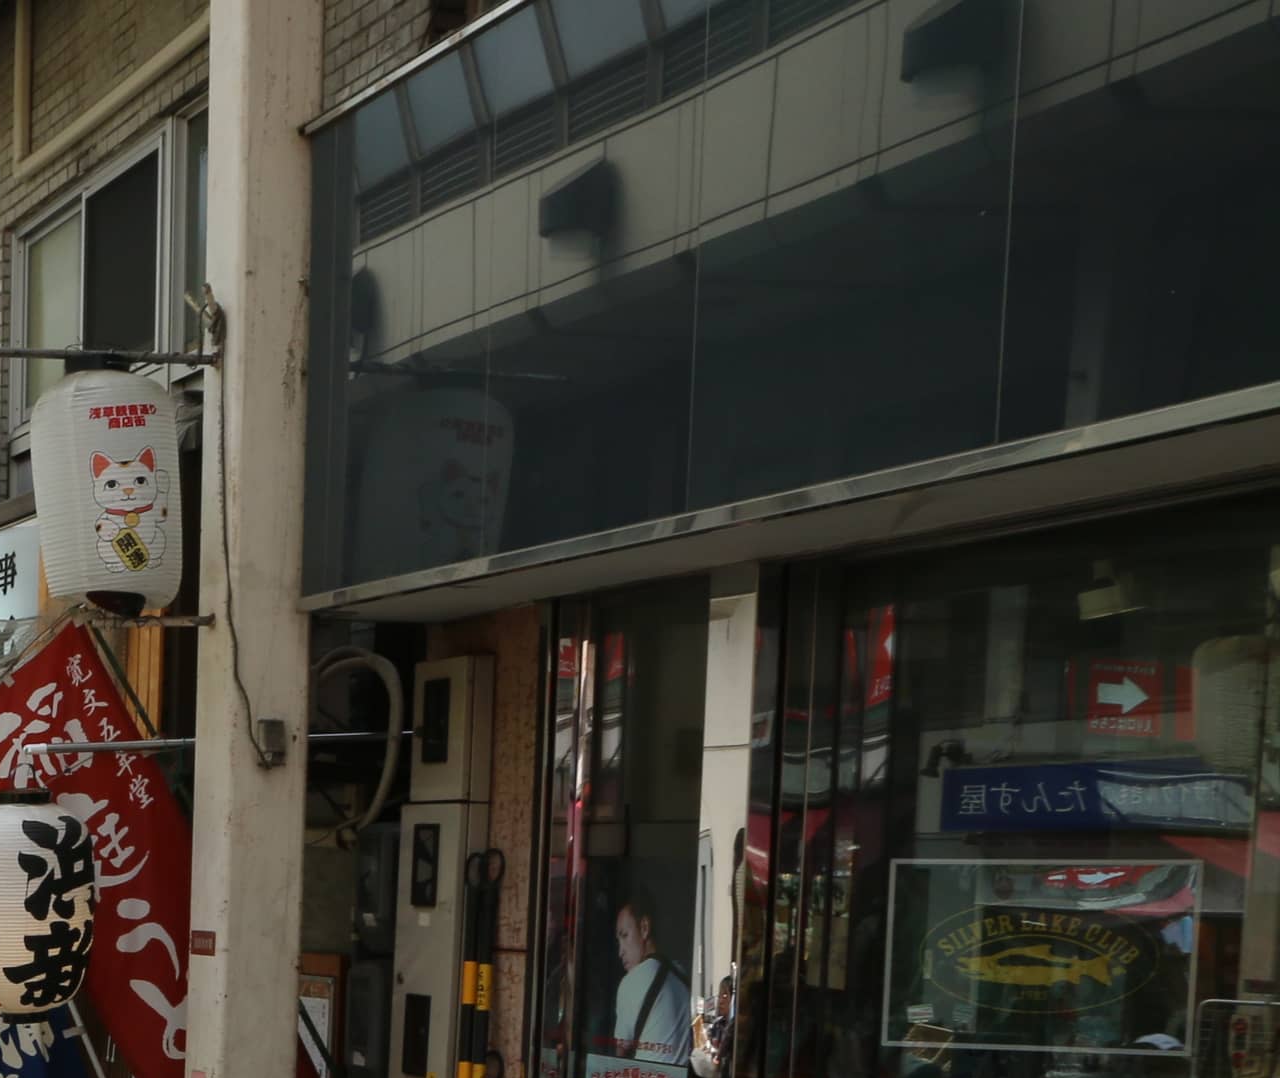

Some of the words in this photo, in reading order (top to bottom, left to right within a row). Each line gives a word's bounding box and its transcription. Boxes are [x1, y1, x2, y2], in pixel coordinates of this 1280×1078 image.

[108, 416, 146, 429] 商店街
[937, 914, 1014, 957] SILVER
[1019, 912, 1082, 936] LAKE
[1083, 923, 1140, 964] CLUB
